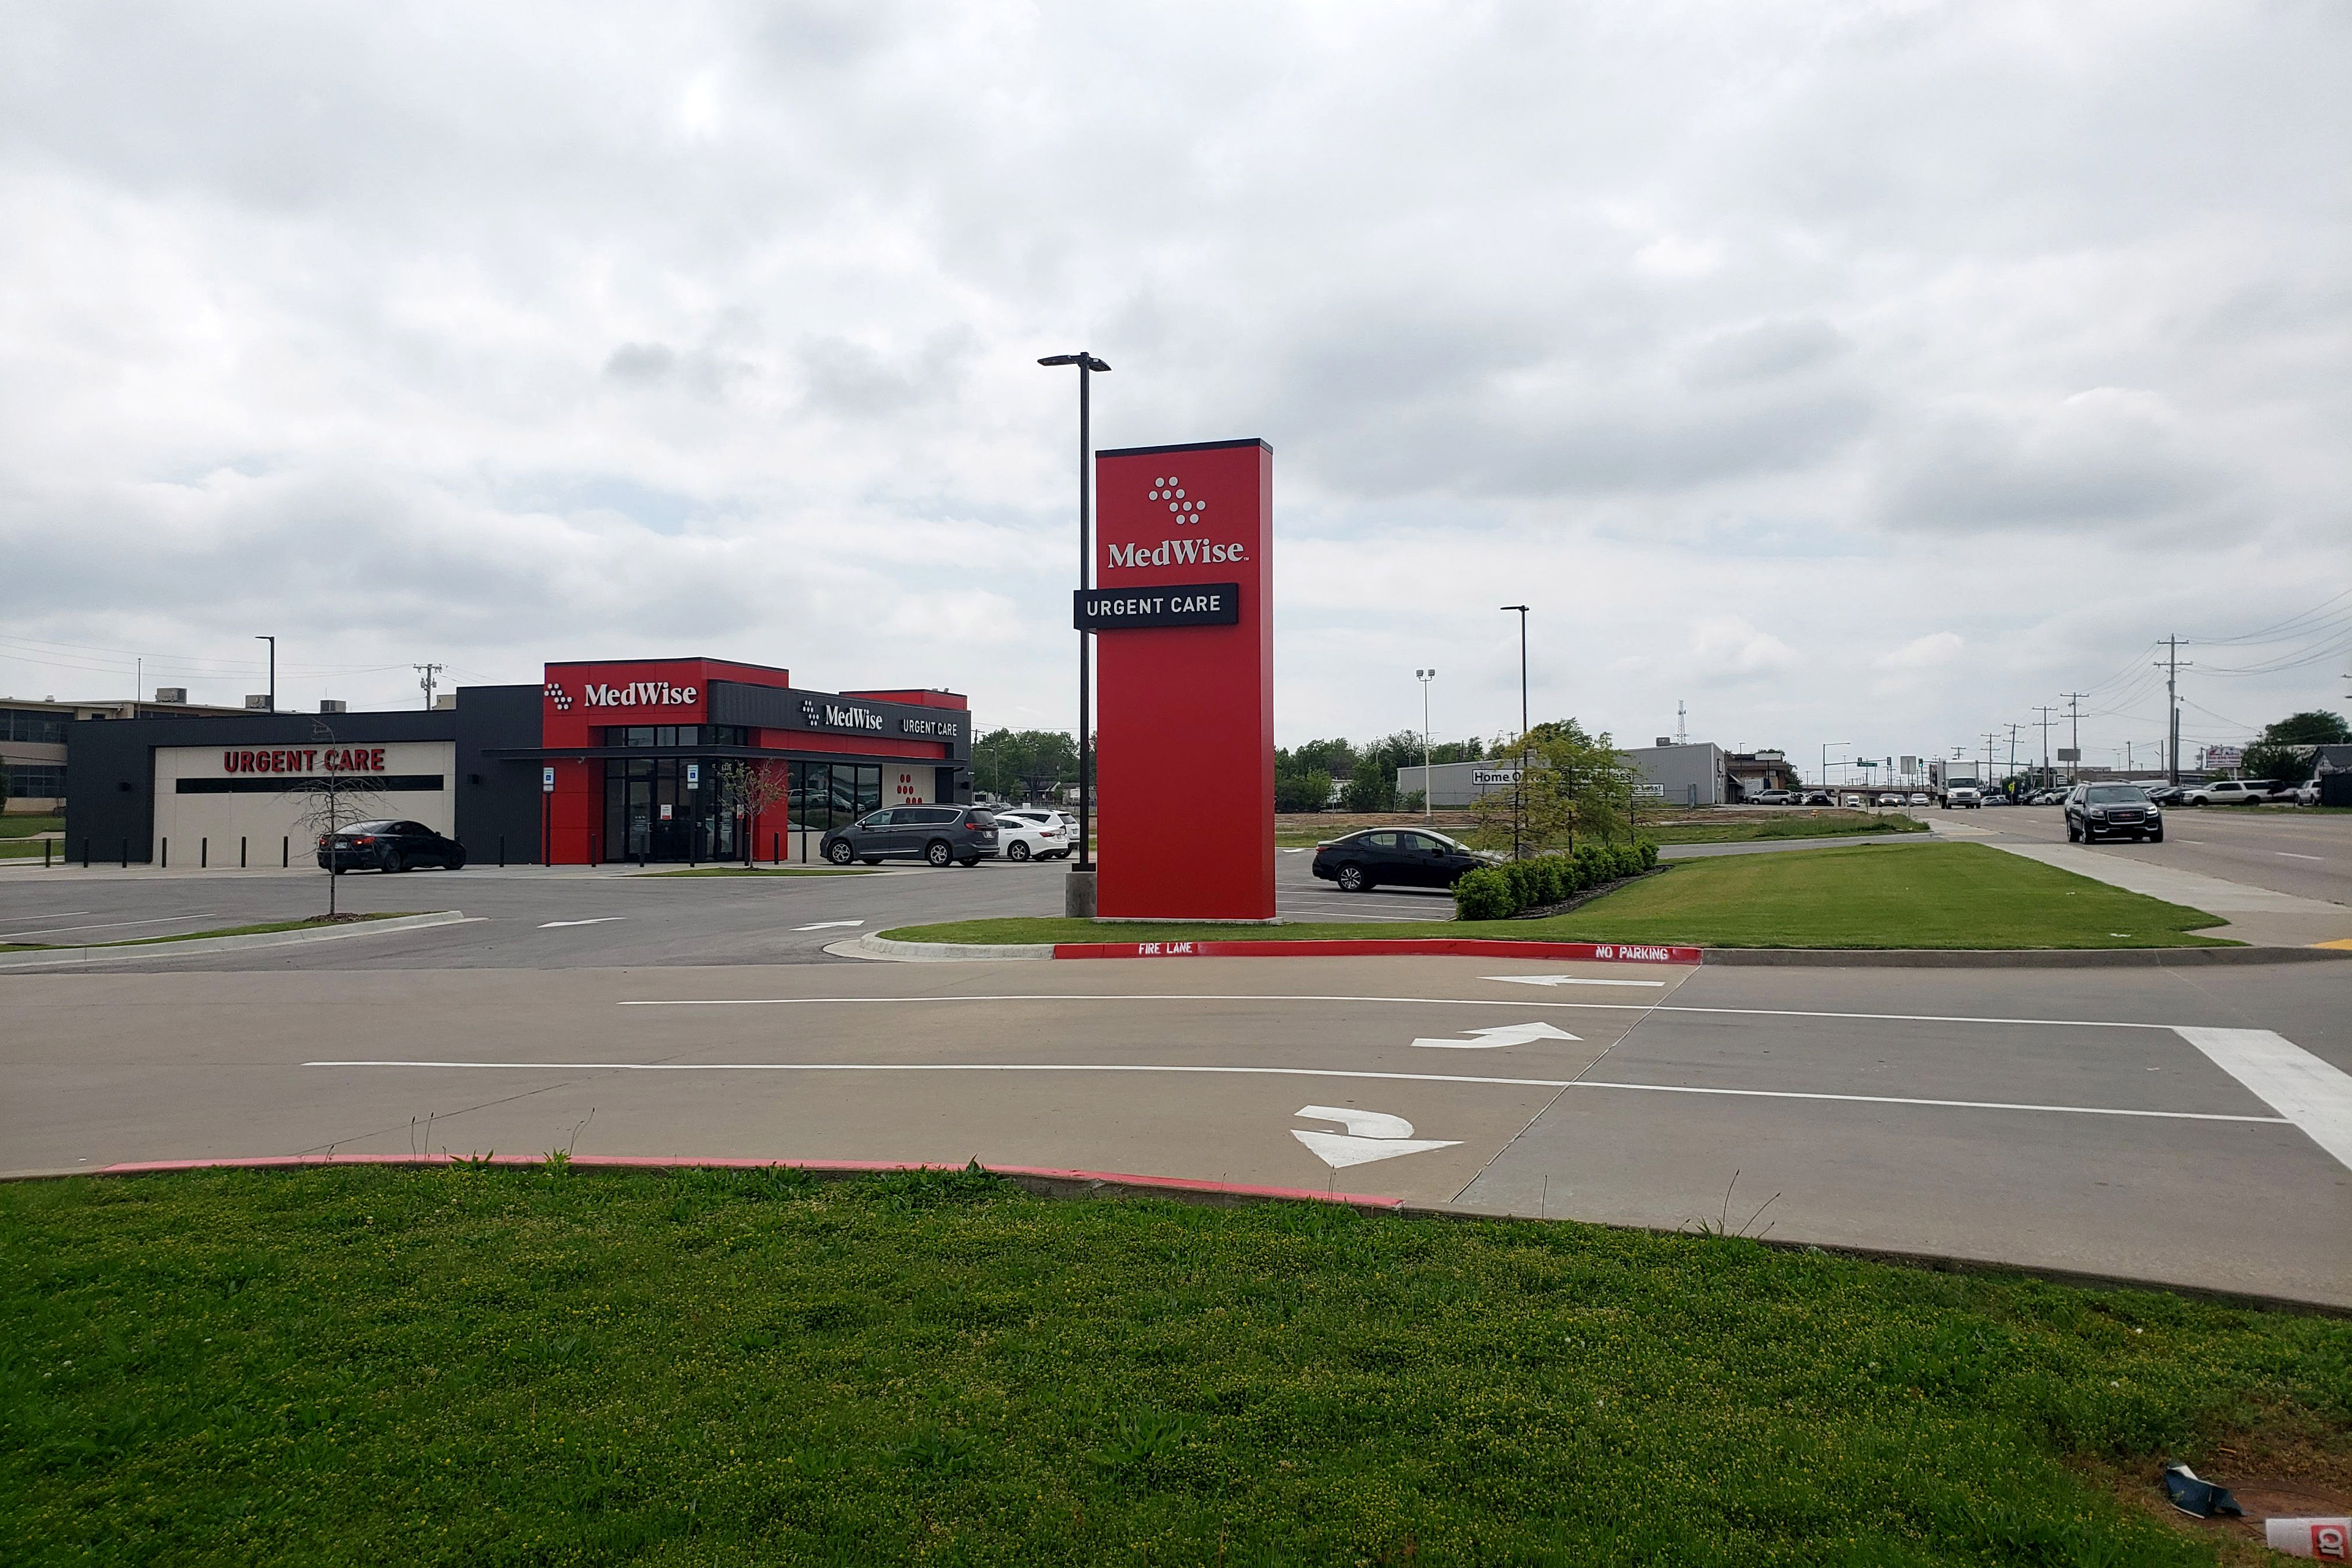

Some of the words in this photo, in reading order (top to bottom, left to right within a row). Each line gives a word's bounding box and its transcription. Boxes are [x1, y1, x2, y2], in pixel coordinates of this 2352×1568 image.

[1107, 538, 1244, 568] MedWise
[1087, 598, 1164, 616] URGENT
[1170, 595, 1221, 612] CARE
[584, 682, 697, 707] MedWise
[825, 704, 883, 730] MedWise
[903, 718, 935, 734] URGENT
[938, 722, 957, 736] CARE
[224, 750, 318, 773] URGENT
[324, 748, 385, 771] CARE
[1474, 772, 1509, 782] Home
[1139, 943, 1162, 955] FIRE
[1166, 942, 1193, 954] LANE
[1596, 946, 1613, 958] NO
[1619, 946, 1669, 960] PARKING
